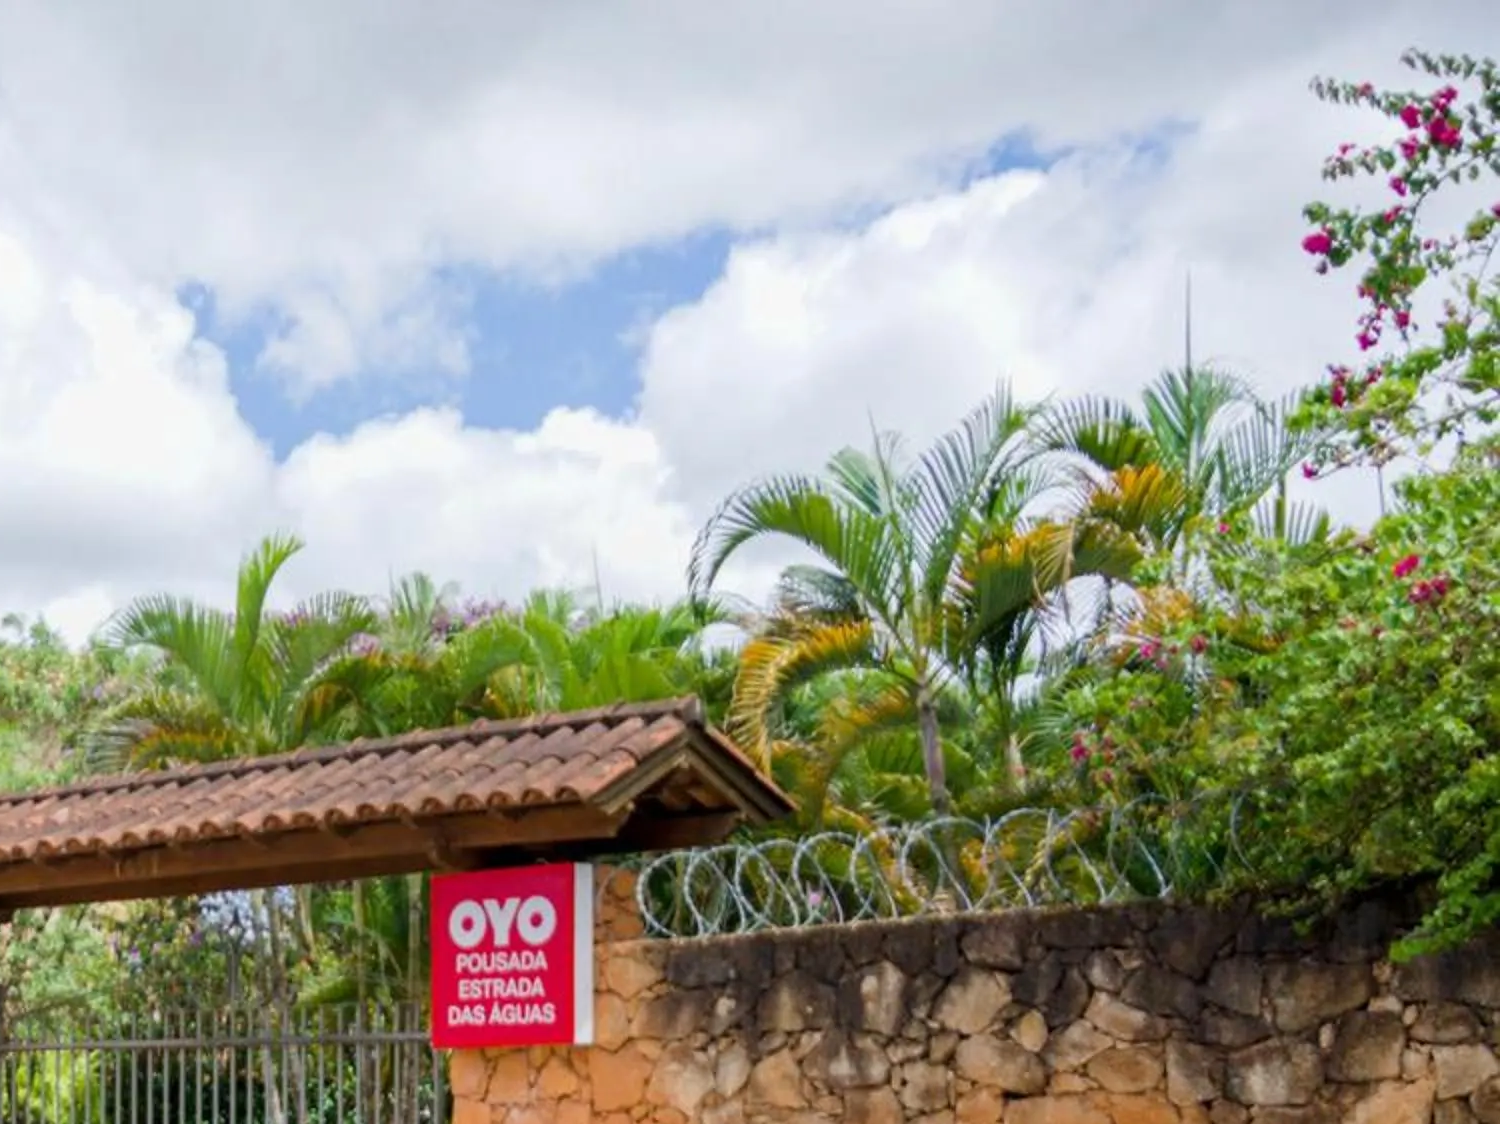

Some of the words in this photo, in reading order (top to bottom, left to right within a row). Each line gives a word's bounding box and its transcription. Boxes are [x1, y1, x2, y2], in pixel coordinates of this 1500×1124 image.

[449, 895, 557, 949] OYO
[456, 950, 547, 973] POUSADA
[458, 976, 545, 999] ESTRADA
[448, 1004, 485, 1026] DAS
[489, 1001, 556, 1025] ÁGUAS
